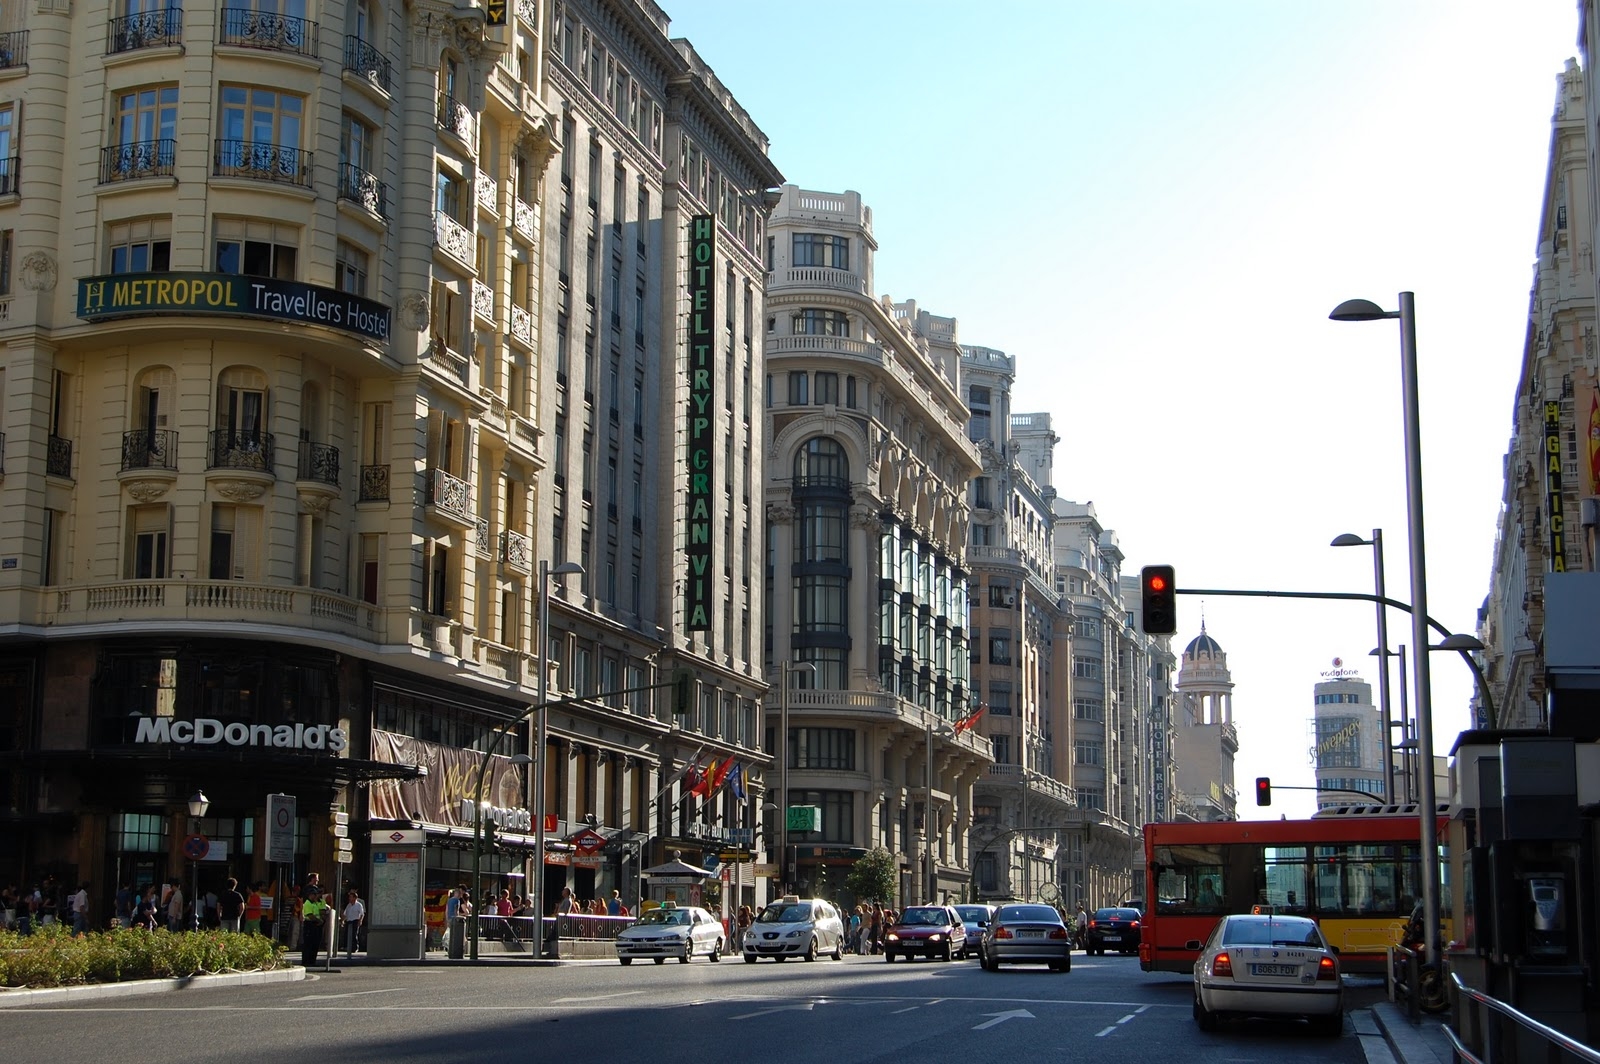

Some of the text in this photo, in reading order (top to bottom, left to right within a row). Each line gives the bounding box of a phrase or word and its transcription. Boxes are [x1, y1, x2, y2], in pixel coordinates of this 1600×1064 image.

[112, 279, 238, 308] METROPOL
[251, 283, 391, 338] Travellers Hostel
[690, 219, 711, 626] HOTEL TRYP GRAN VIA
[1546, 436, 1566, 573] GALICIA
[1320, 668, 1359, 677] vodafone
[135, 717, 347, 751] McDonald's
[1309, 718, 1361, 764] Schweppes
[1257, 965, 1278, 974] 6063
